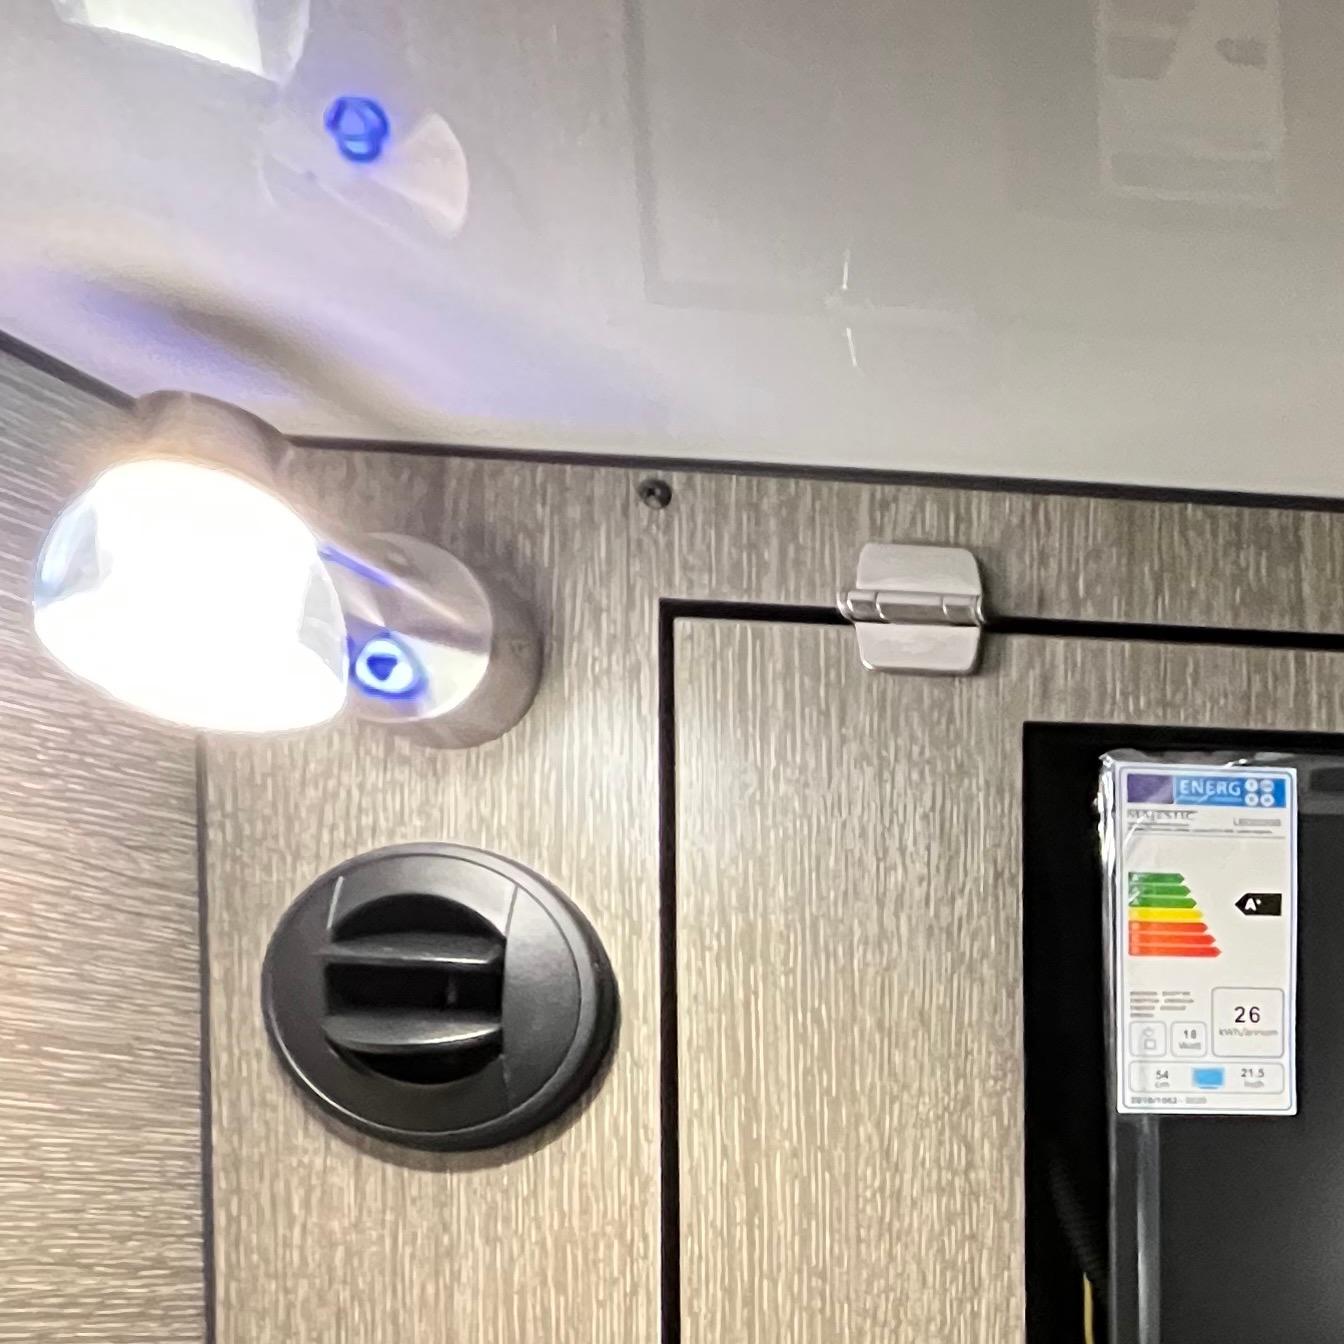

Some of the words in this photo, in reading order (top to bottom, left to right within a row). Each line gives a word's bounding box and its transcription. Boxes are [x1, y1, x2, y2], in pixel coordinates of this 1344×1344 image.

[1179, 778, 1241, 796] ENERG
[1234, 1006, 1261, 1024] 26
[1156, 1070, 1169, 1080] 54
